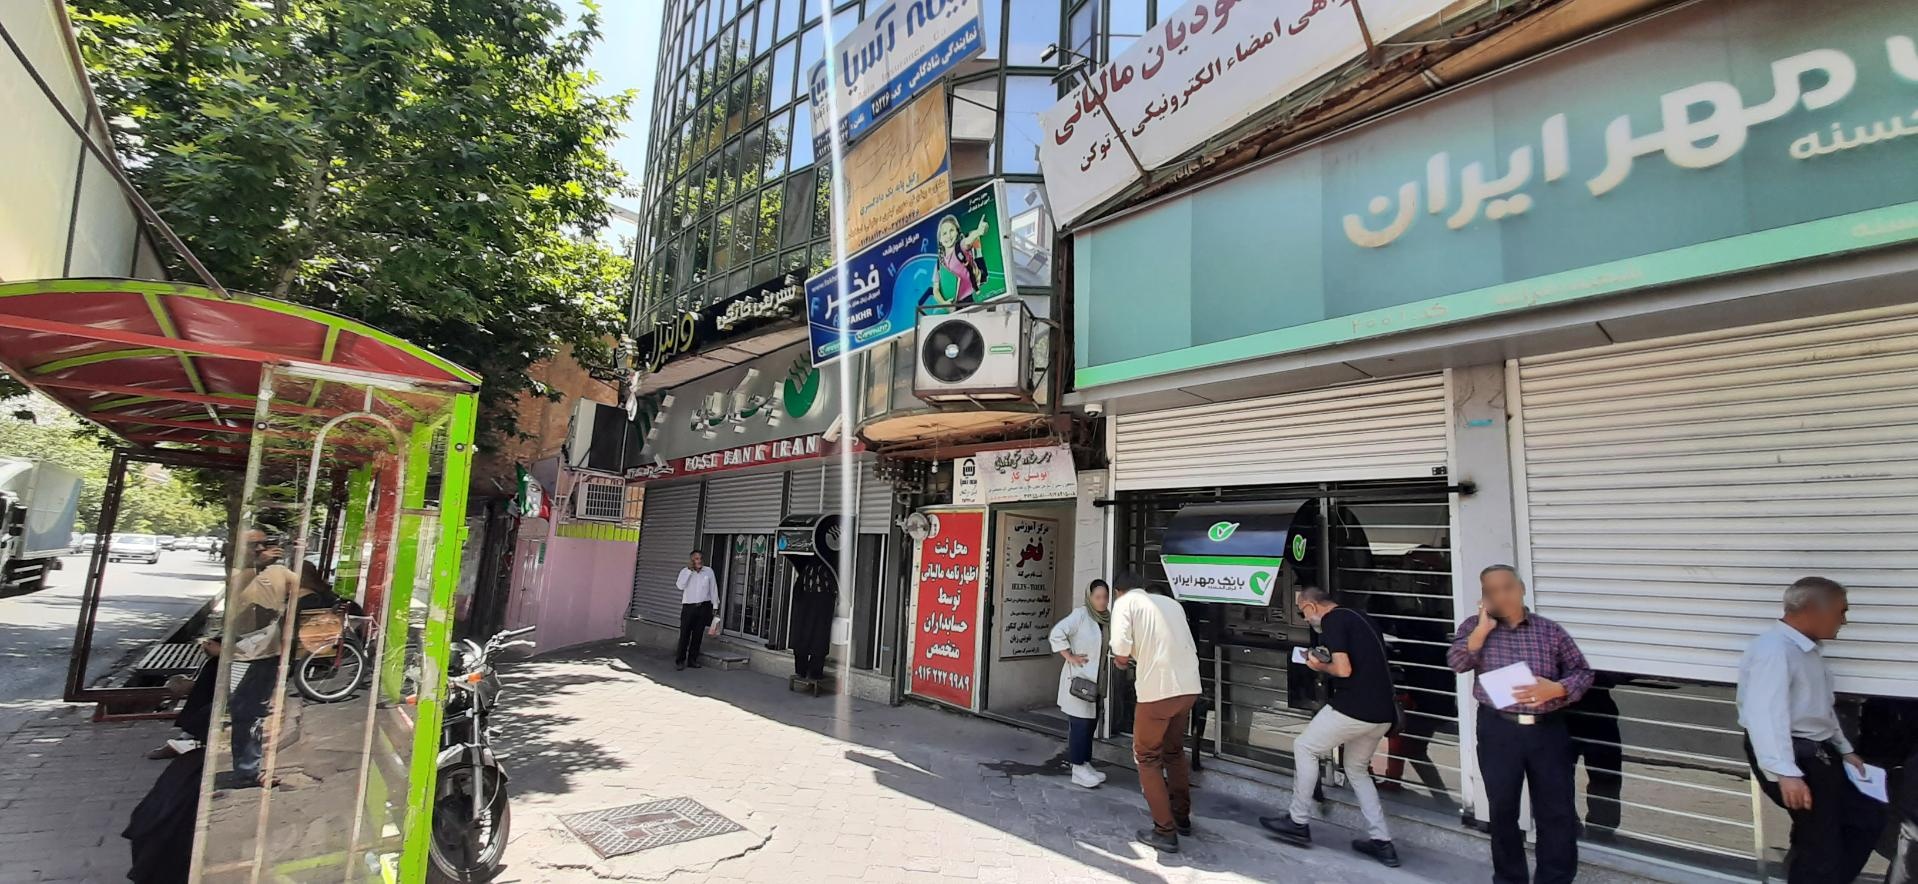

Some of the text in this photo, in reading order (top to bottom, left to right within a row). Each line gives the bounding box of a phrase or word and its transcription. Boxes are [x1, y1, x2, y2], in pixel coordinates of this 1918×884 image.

[843, 3, 896, 96] آسیا
[941, 25, 978, 65] نمایندگی
[1142, 0, 1242, 80] ودیان
[1056, 62, 1134, 145] مالیاتی
[1132, 56, 1221, 137] الکترونیکی
[1080, 132, 1112, 172] توکن
[1342, 47, 1857, 250] مهر ایران
[824, 264, 880, 320] فخر
[685, 453, 718, 472] POST
[724, 445, 767, 466] BANK
[773, 435, 820, 460] IRAN
[934, 538, 968, 559] محل ثبت
[1016, 536, 1044, 568] فخر
[921, 563, 945, 582] مالیاتی
[1172, 575, 1245, 590] بانک مهر ایران
[937, 587, 961, 611] توسط
[923, 612, 968, 635] حسابداران
[926, 640, 961, 660] متخصص
